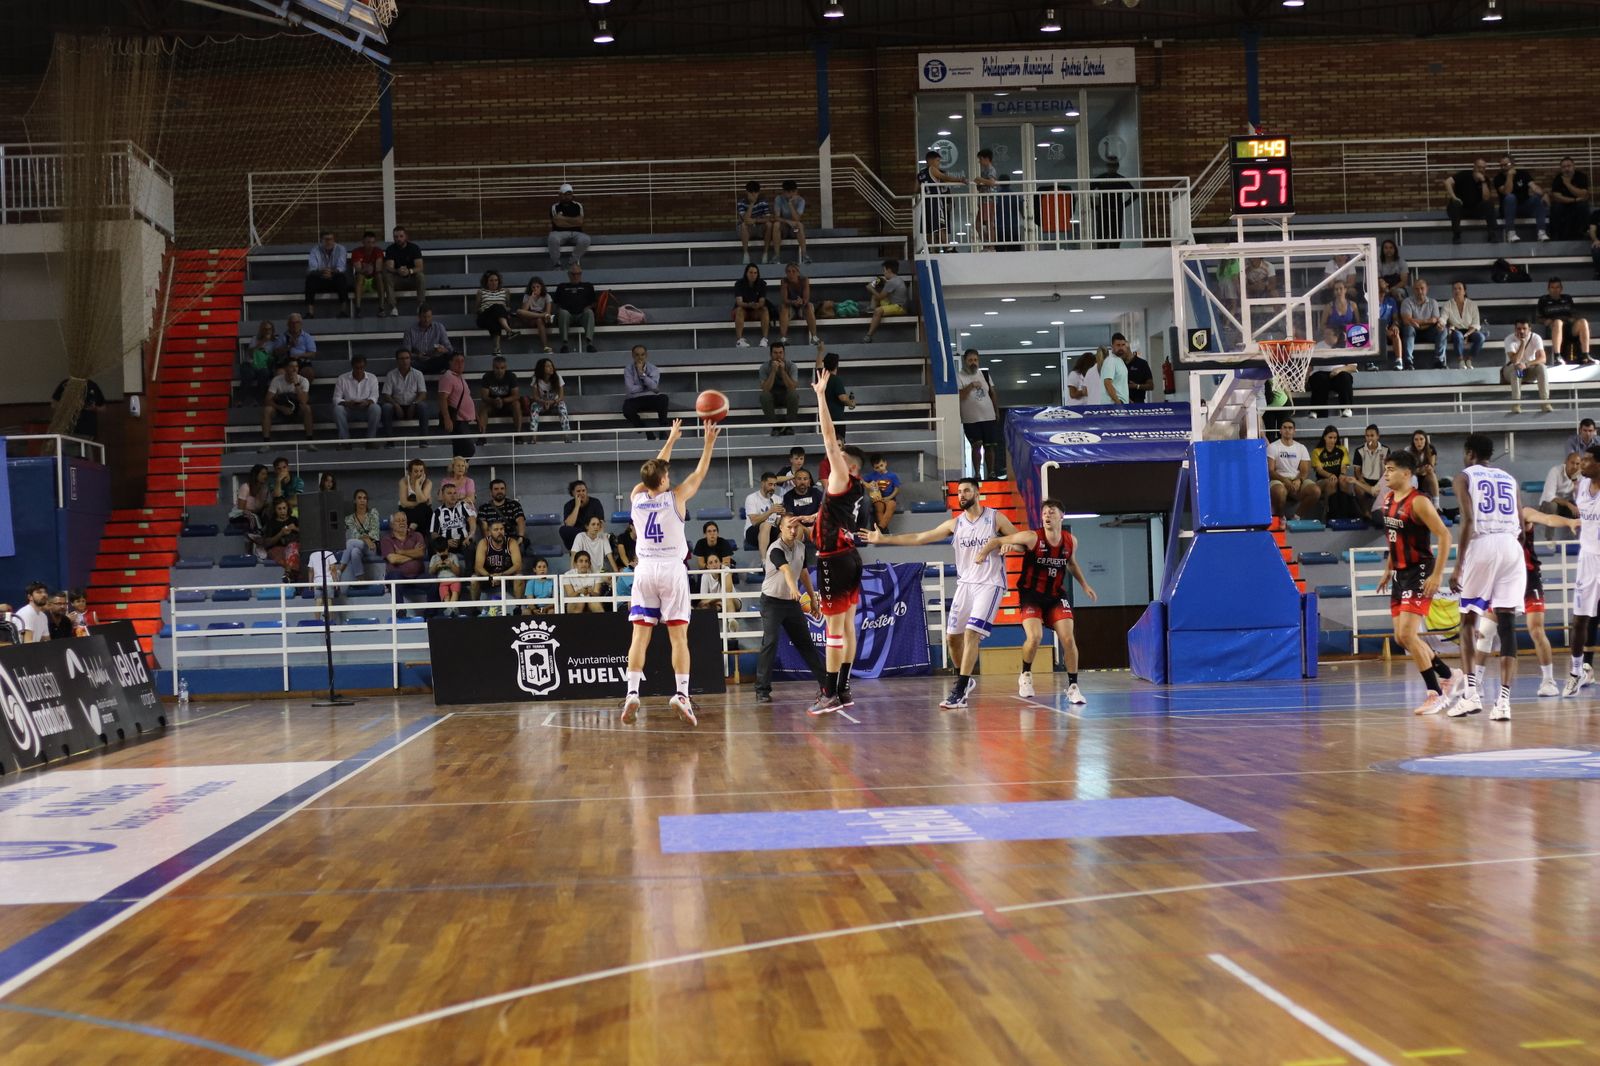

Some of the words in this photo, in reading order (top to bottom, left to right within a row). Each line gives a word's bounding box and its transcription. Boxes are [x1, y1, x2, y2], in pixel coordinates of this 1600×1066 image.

[996, 100, 1075, 112] CAFETERIA
[1248, 139, 1286, 157] 7:49
[1240, 169, 1287, 208] 2.7
[1478, 480, 1515, 515] 35
[644, 511, 664, 543] 4
[1048, 567, 1057, 578] 18
[861, 612, 896, 630] bestén
